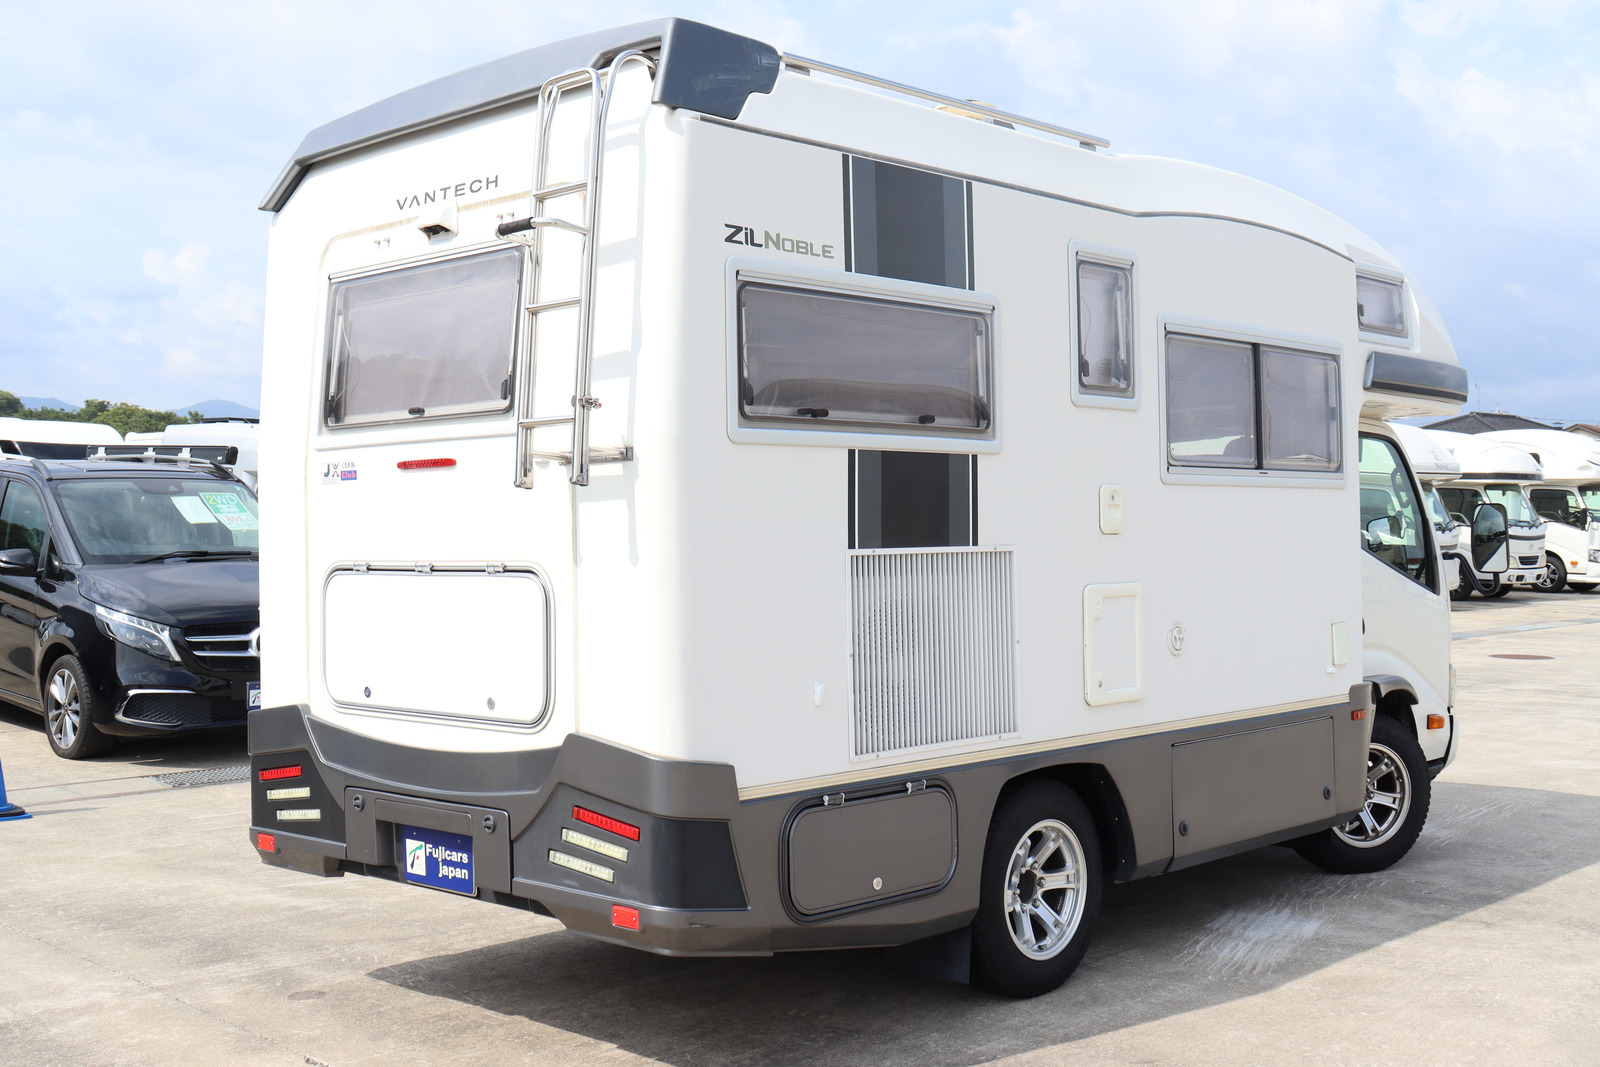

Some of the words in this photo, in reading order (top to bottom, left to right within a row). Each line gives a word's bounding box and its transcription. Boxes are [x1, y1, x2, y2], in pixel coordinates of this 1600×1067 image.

[396, 174, 499, 211] VANTECH
[341, 471, 356, 479] Club
[206, 495, 238, 505] 2WD
[426, 843, 469, 864] Fujicars
